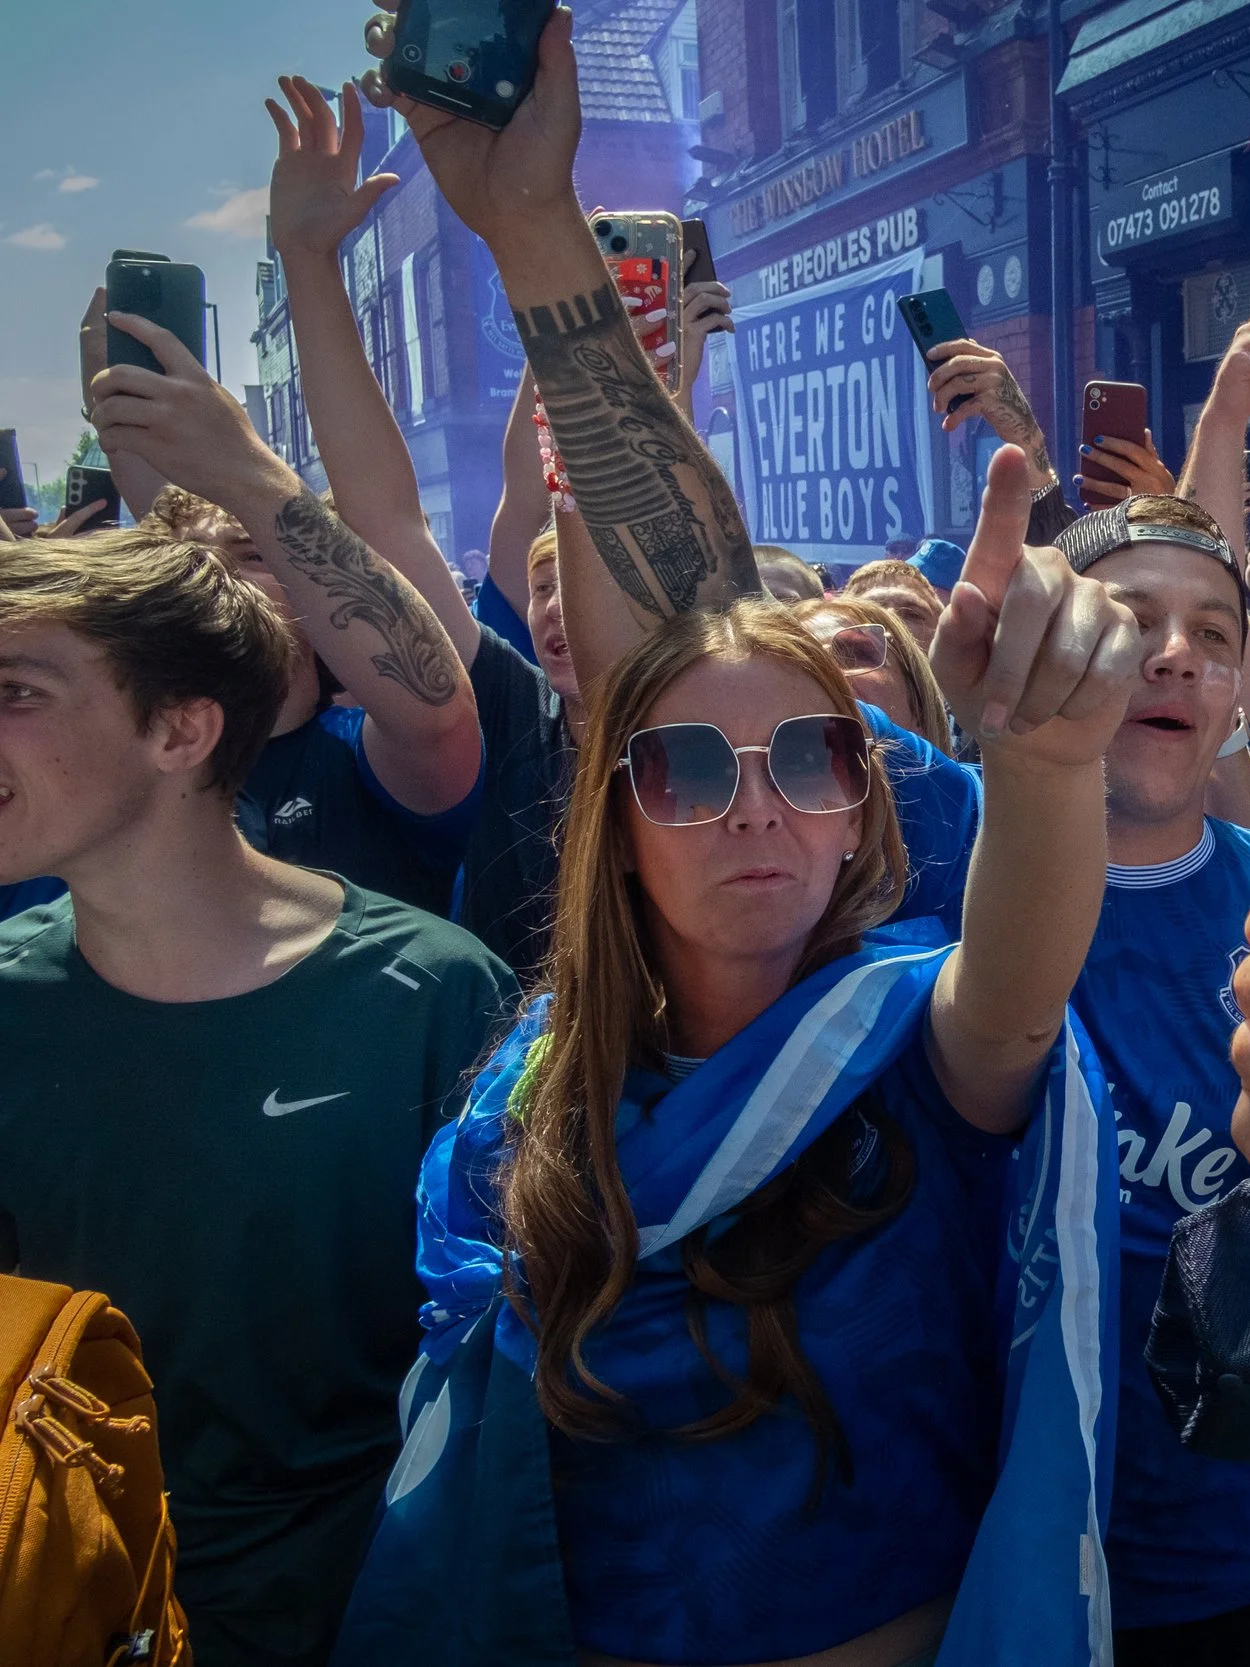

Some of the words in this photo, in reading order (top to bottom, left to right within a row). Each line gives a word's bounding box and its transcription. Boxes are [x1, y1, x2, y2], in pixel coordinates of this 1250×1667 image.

[852, 110, 926, 177] HOTEL
[1108, 208, 1153, 246] 07473
[1160, 187, 1220, 230] 091278
[1142, 175, 1178, 200] Contact
[759, 261, 789, 300] THE
[793, 226, 872, 288] PEOPLES
[877, 207, 918, 257] PUB
[748, 315, 801, 371] HERE
[816, 303, 845, 355] WE
[862, 289, 896, 344] GO
[490, 388, 516, 397] Bram
[504, 369, 523, 378] Wel
[752, 355, 901, 477] EVERTON
[762, 479, 810, 540] BLUE
[819, 476, 902, 541] BOYS
[1114, 1101, 1237, 1213] ake
